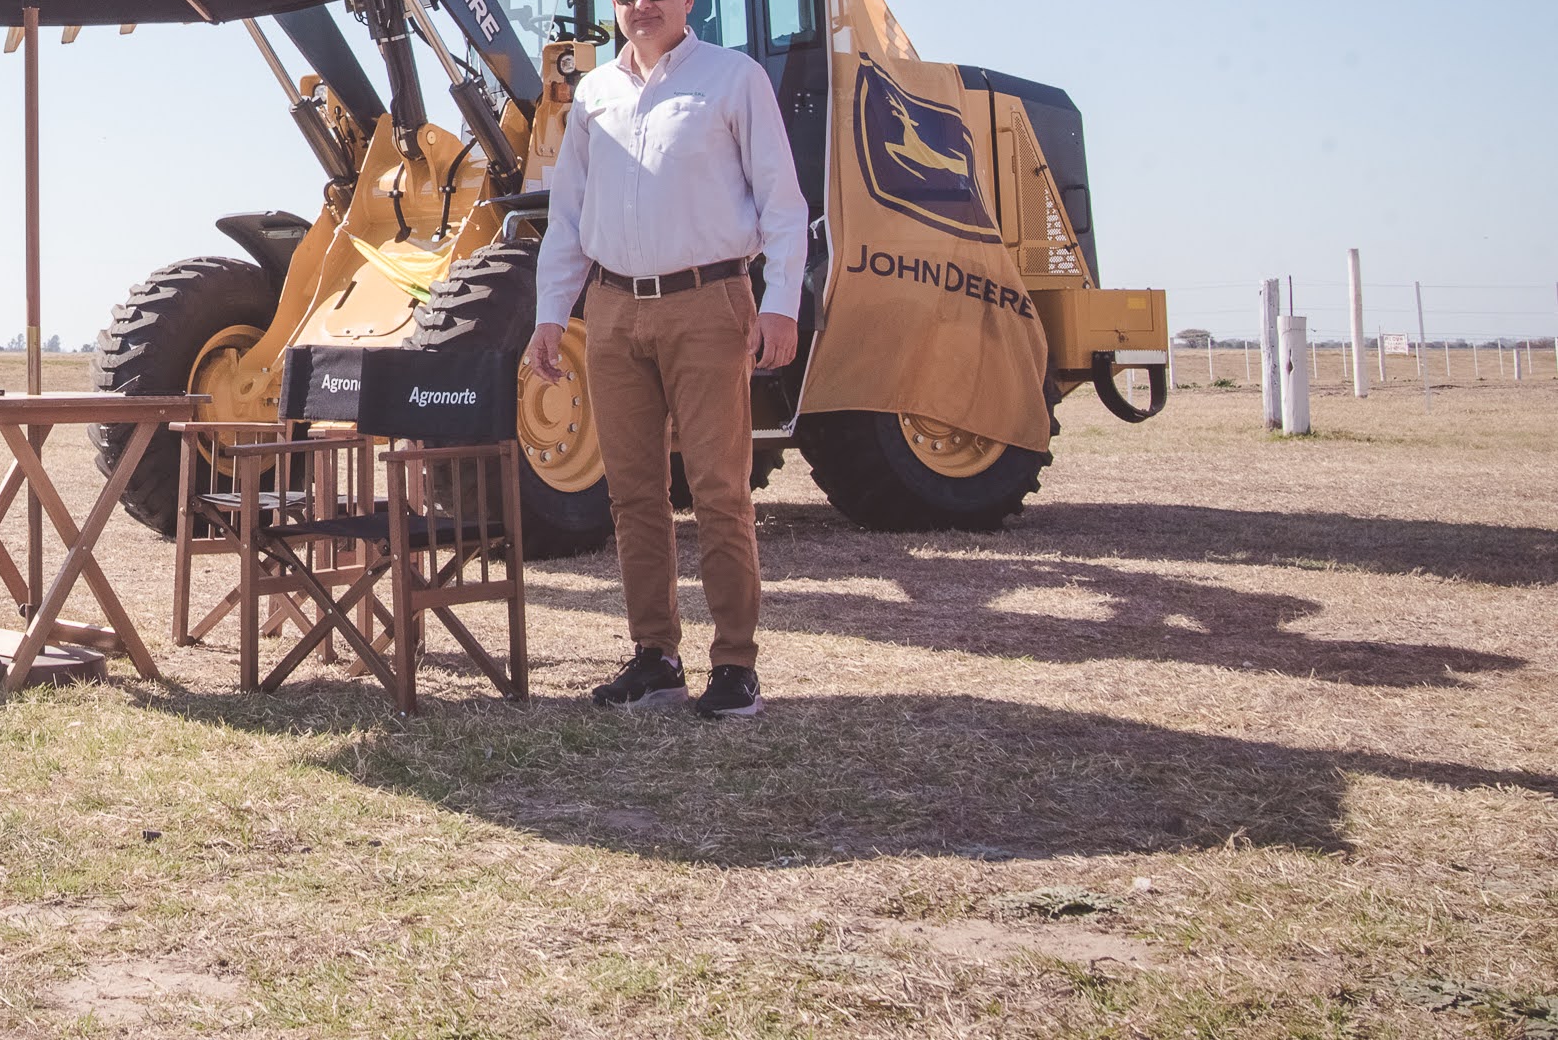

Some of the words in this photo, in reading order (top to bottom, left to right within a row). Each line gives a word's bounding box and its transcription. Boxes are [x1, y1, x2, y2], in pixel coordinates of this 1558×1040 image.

[847, 244, 941, 287] JOHN
[944, 261, 1034, 320] DEERE
[408, 386, 477, 407] Agronorte
